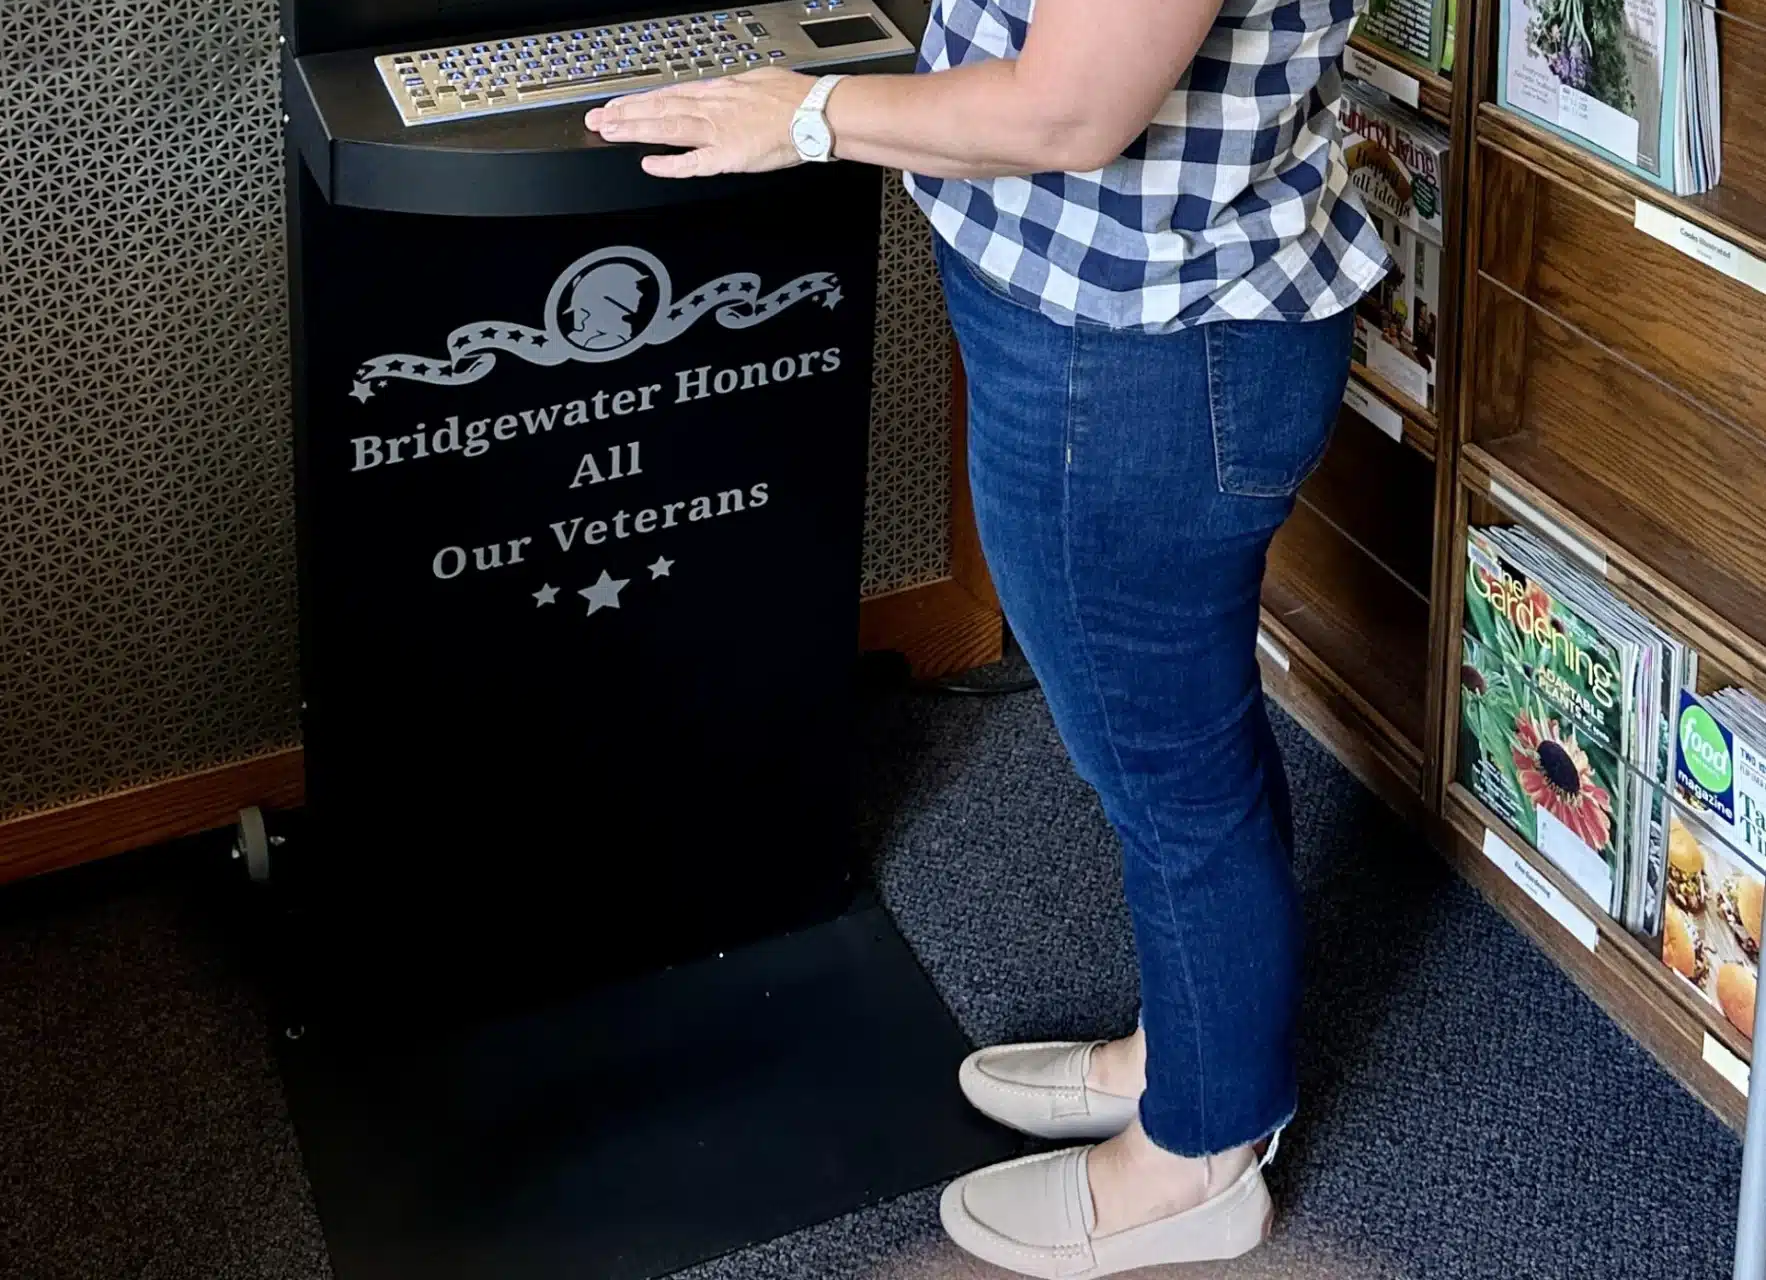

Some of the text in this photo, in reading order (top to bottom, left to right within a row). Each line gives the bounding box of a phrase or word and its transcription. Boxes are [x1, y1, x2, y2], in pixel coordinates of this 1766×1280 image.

[350, 346, 842, 472] Bridgewater Honors
[568, 441, 643, 489] All
[432, 481, 770, 580] Our Veterans
[1468, 558, 1614, 709] Gardening
[1682, 716, 1731, 776] food
[1677, 768, 1734, 820] magazine
